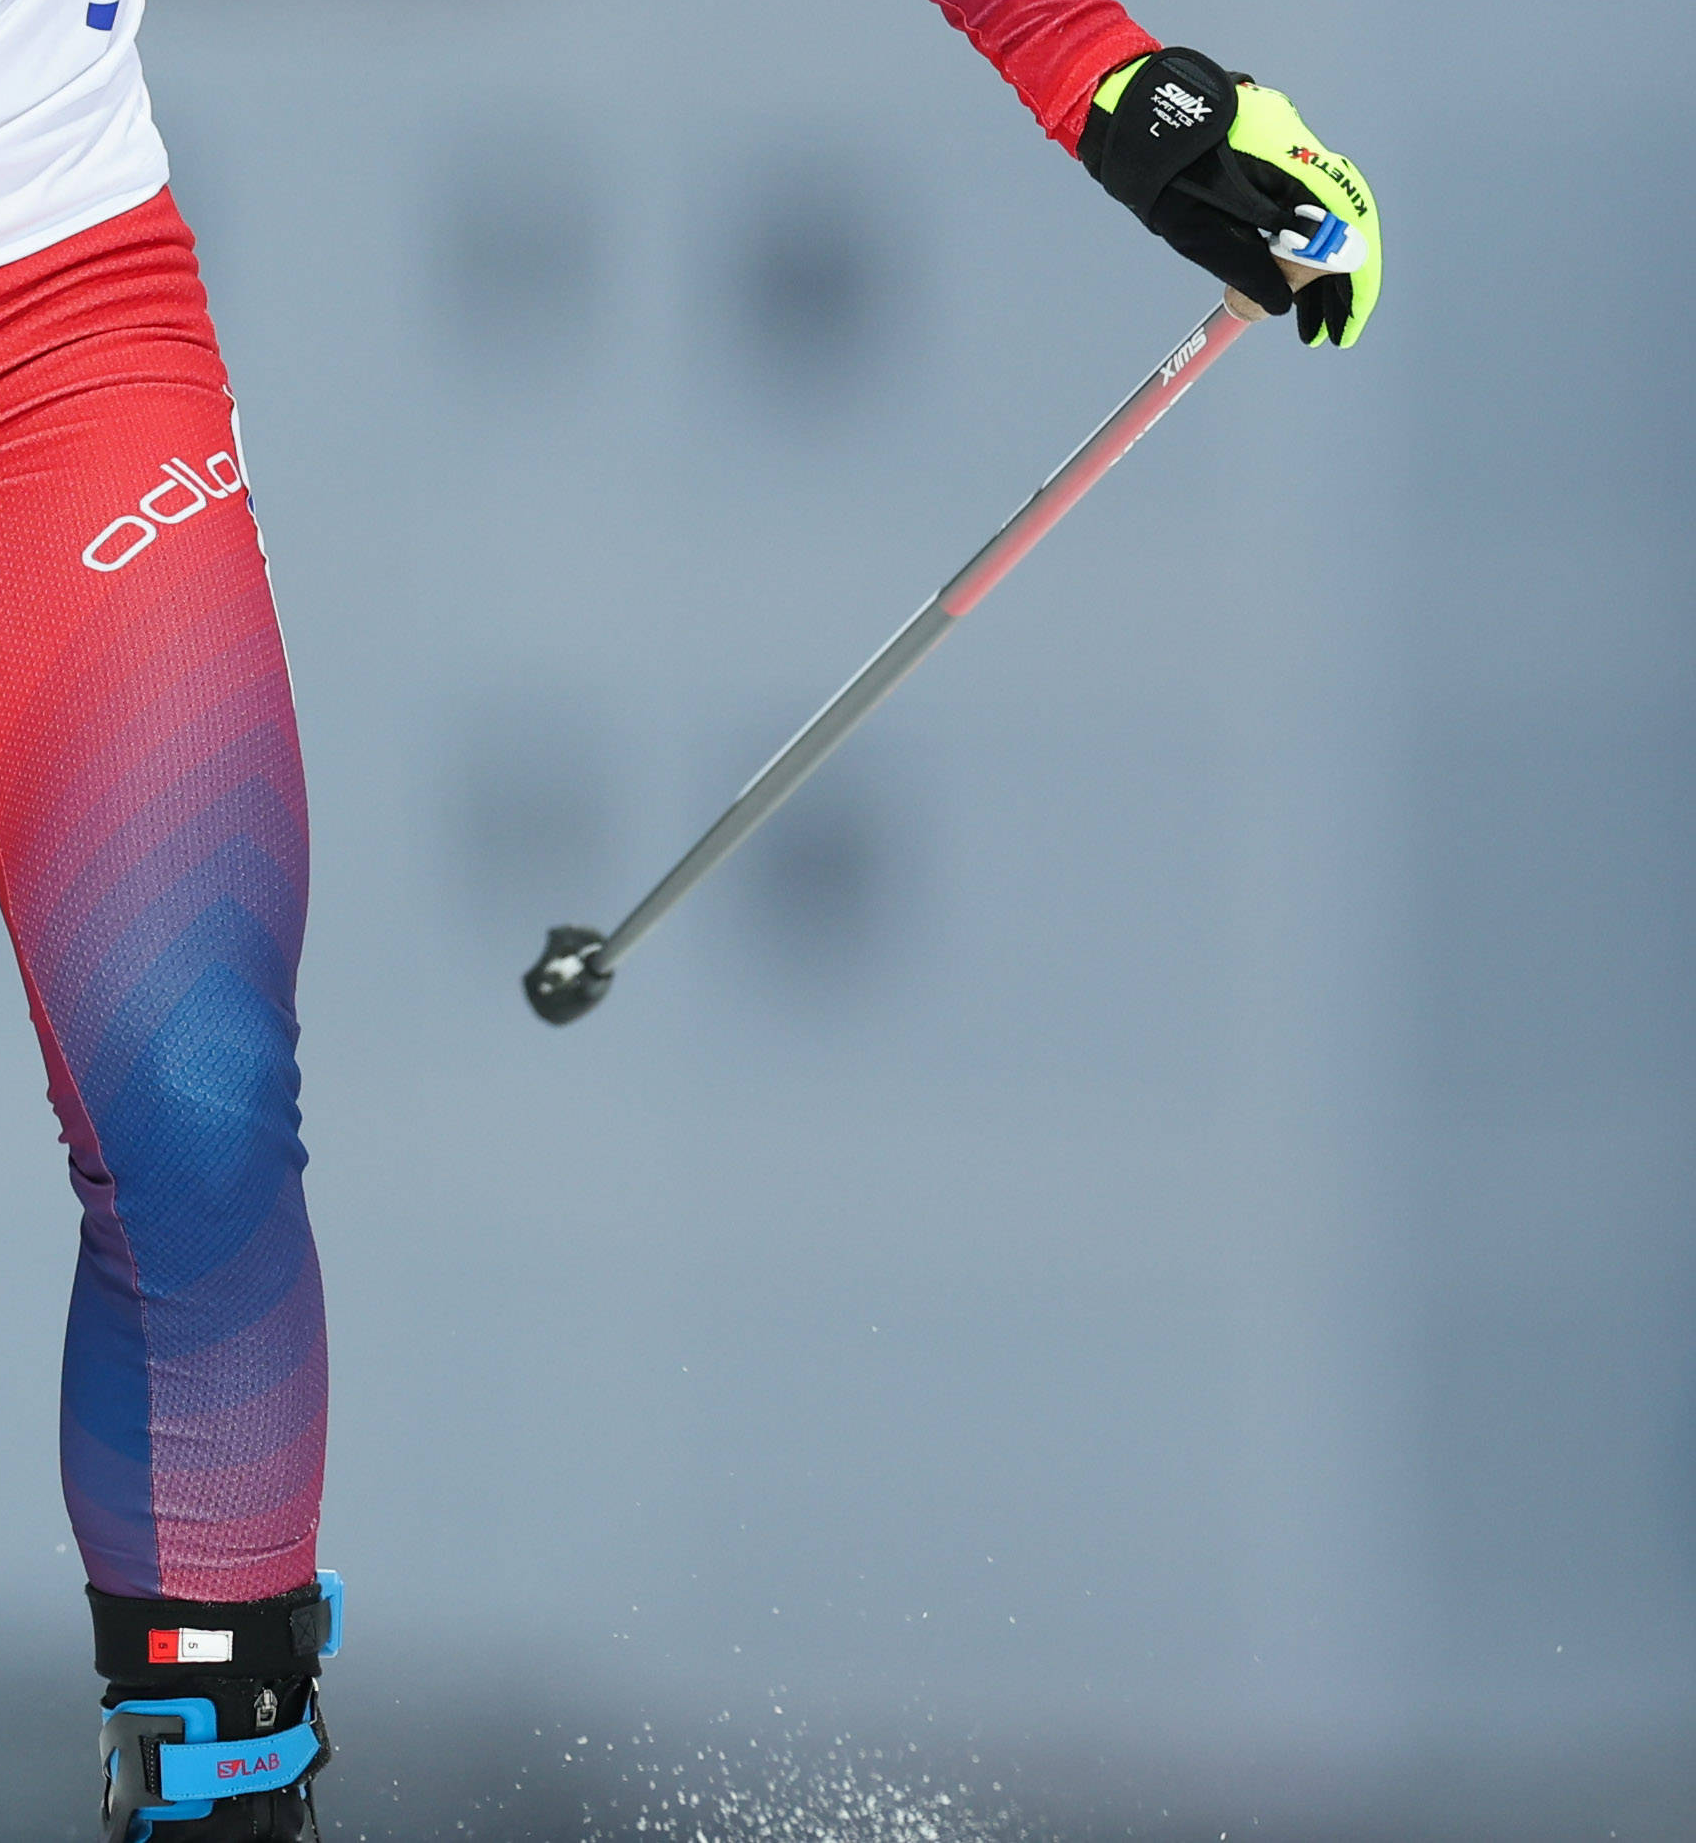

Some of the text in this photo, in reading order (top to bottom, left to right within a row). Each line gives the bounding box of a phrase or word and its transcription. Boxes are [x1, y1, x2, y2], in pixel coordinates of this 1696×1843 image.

[1175, 109, 1195, 128] TCS
[1149, 121, 1160, 137] L
[81, 451, 242, 572] odlo
